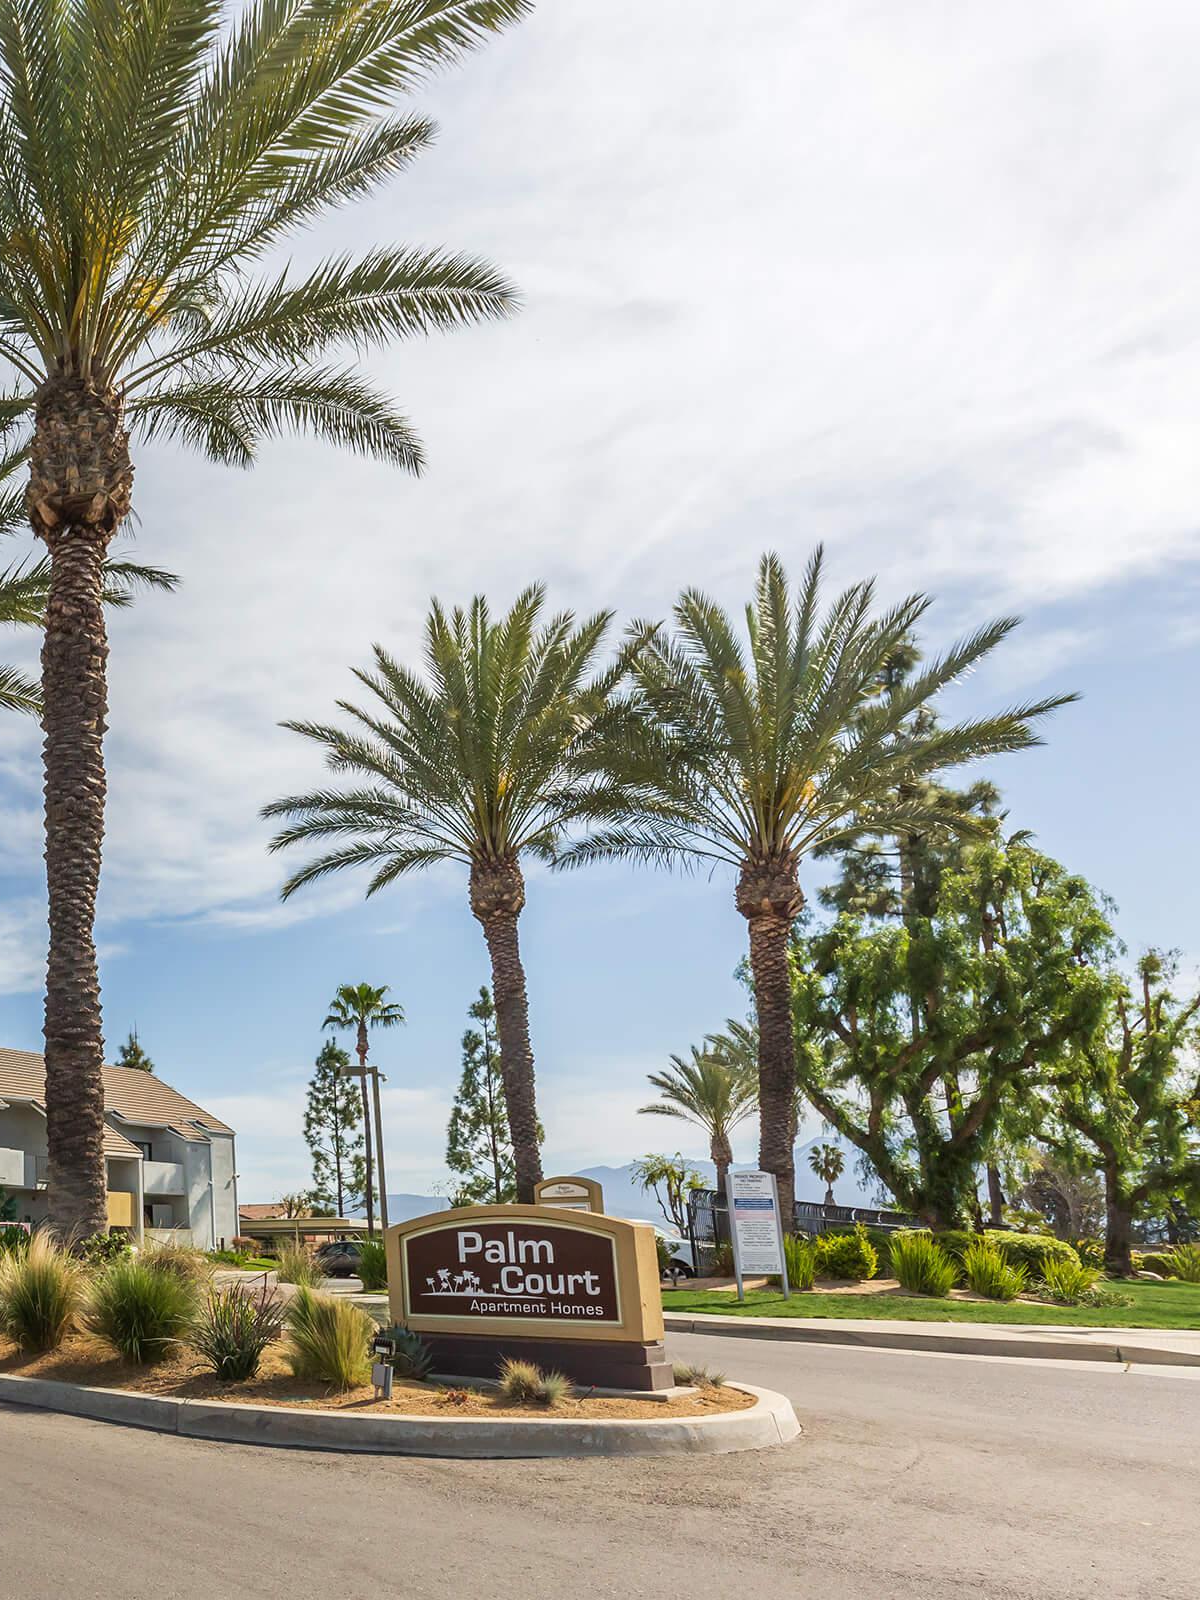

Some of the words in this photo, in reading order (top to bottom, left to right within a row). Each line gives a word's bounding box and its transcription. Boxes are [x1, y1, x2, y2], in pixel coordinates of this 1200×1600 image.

[457, 1231, 554, 1264] Palm
[500, 1265, 601, 1296] Court
[470, 1299, 547, 1314] Apartment
[551, 1301, 604, 1316] Homes
